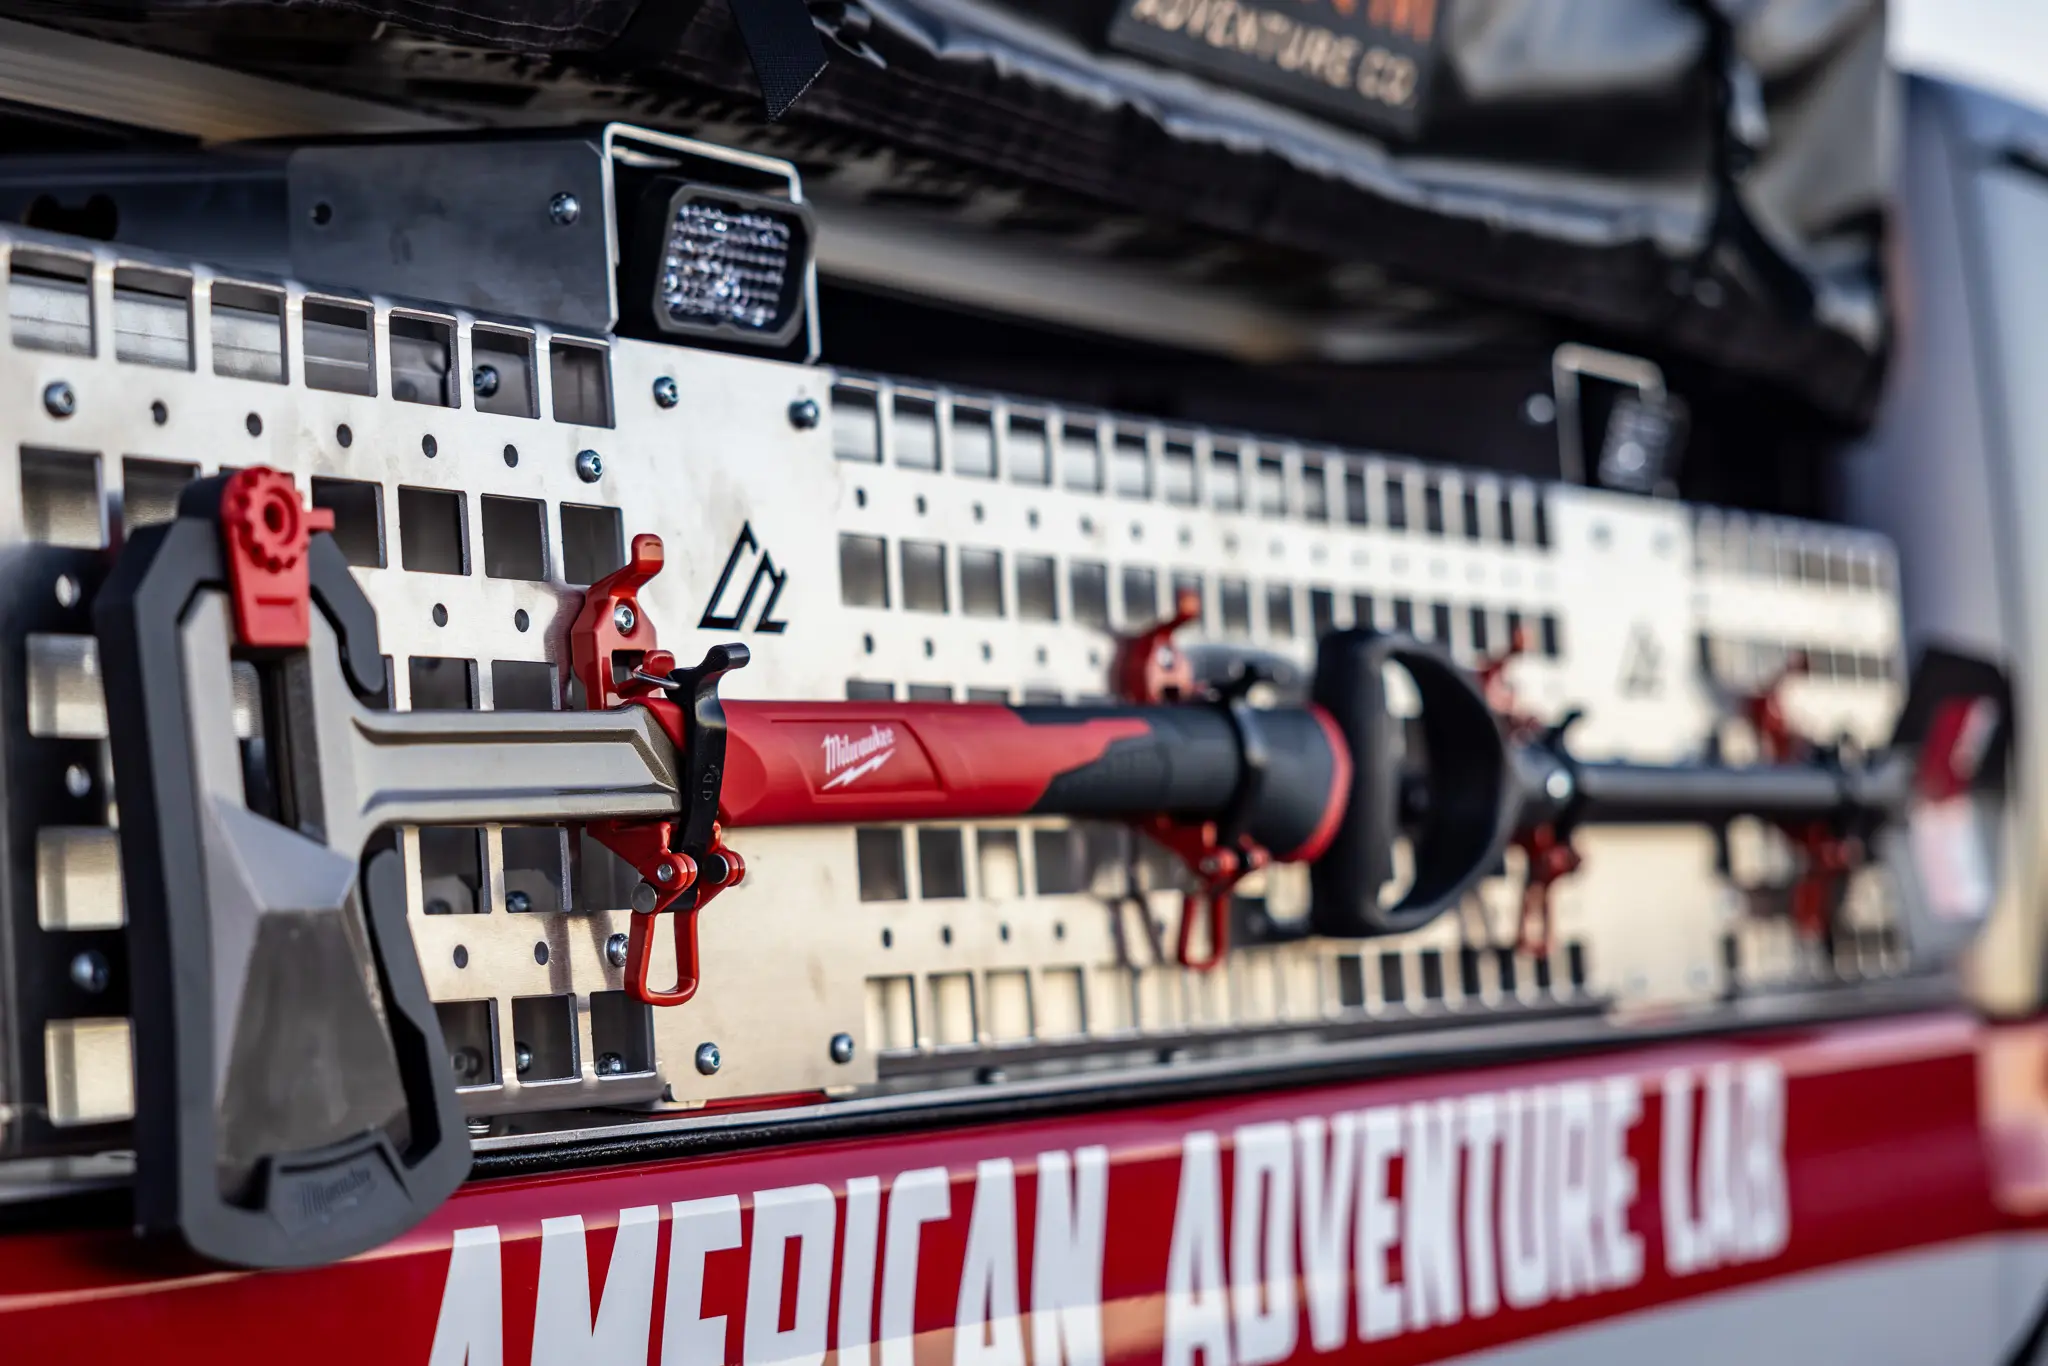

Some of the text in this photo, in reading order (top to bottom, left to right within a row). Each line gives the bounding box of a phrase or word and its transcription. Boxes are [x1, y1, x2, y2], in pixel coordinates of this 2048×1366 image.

[821, 724, 895, 775] Milwaukee
[1163, 1077, 1643, 1366] ADVENTURE
[1662, 1059, 1788, 1273] LAB
